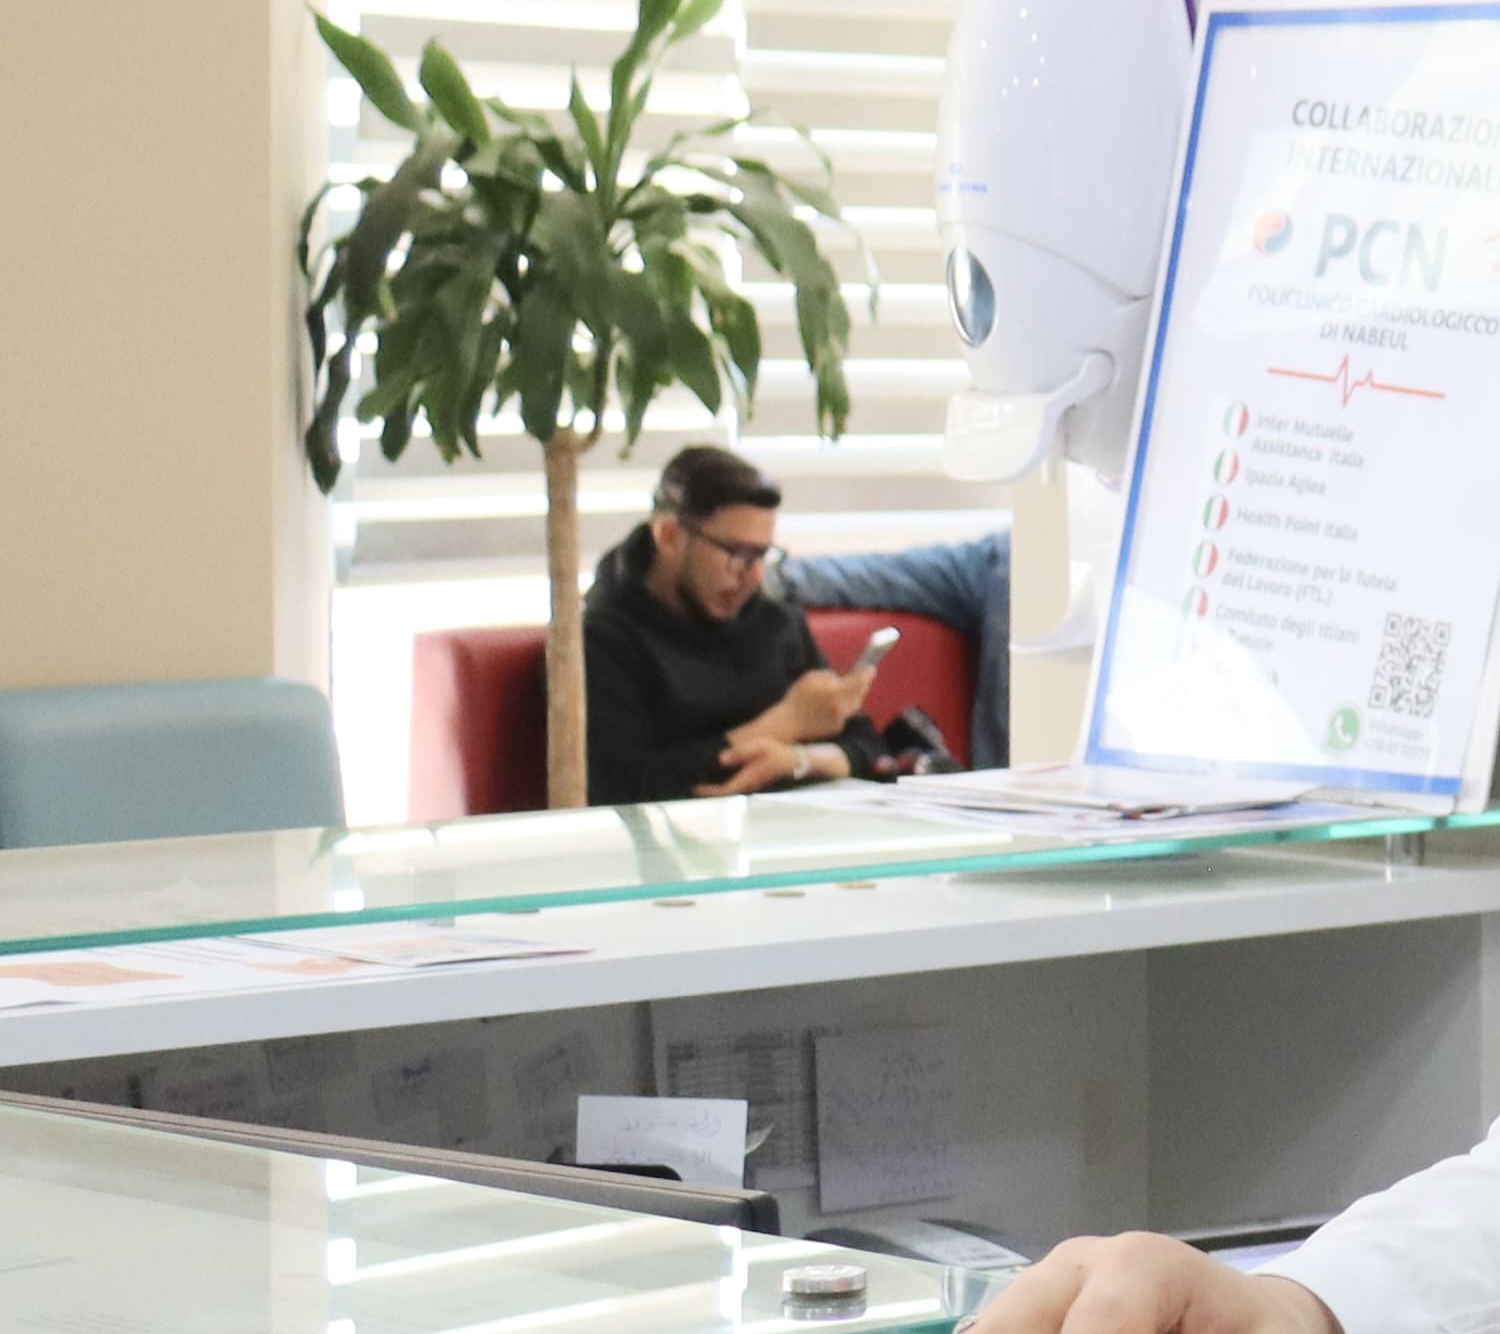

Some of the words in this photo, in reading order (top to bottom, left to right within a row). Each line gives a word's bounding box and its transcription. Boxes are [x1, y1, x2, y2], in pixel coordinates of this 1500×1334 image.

[1314, 212, 1449, 295] PCN
[1319, 322, 1337, 340] DI
[1341, 324, 1409, 351] NABEUL
[1257, 413, 1289, 432] Inter
[1252, 437, 1323, 463] Assistance
[1237, 507, 1281, 528] Health
[1284, 514, 1320, 536] Point
[1228, 547, 1310, 577] Federazione
[1313, 563, 1336, 582] per
[1222, 570, 1243, 588] del
[1246, 574, 1292, 598] Lavoro
